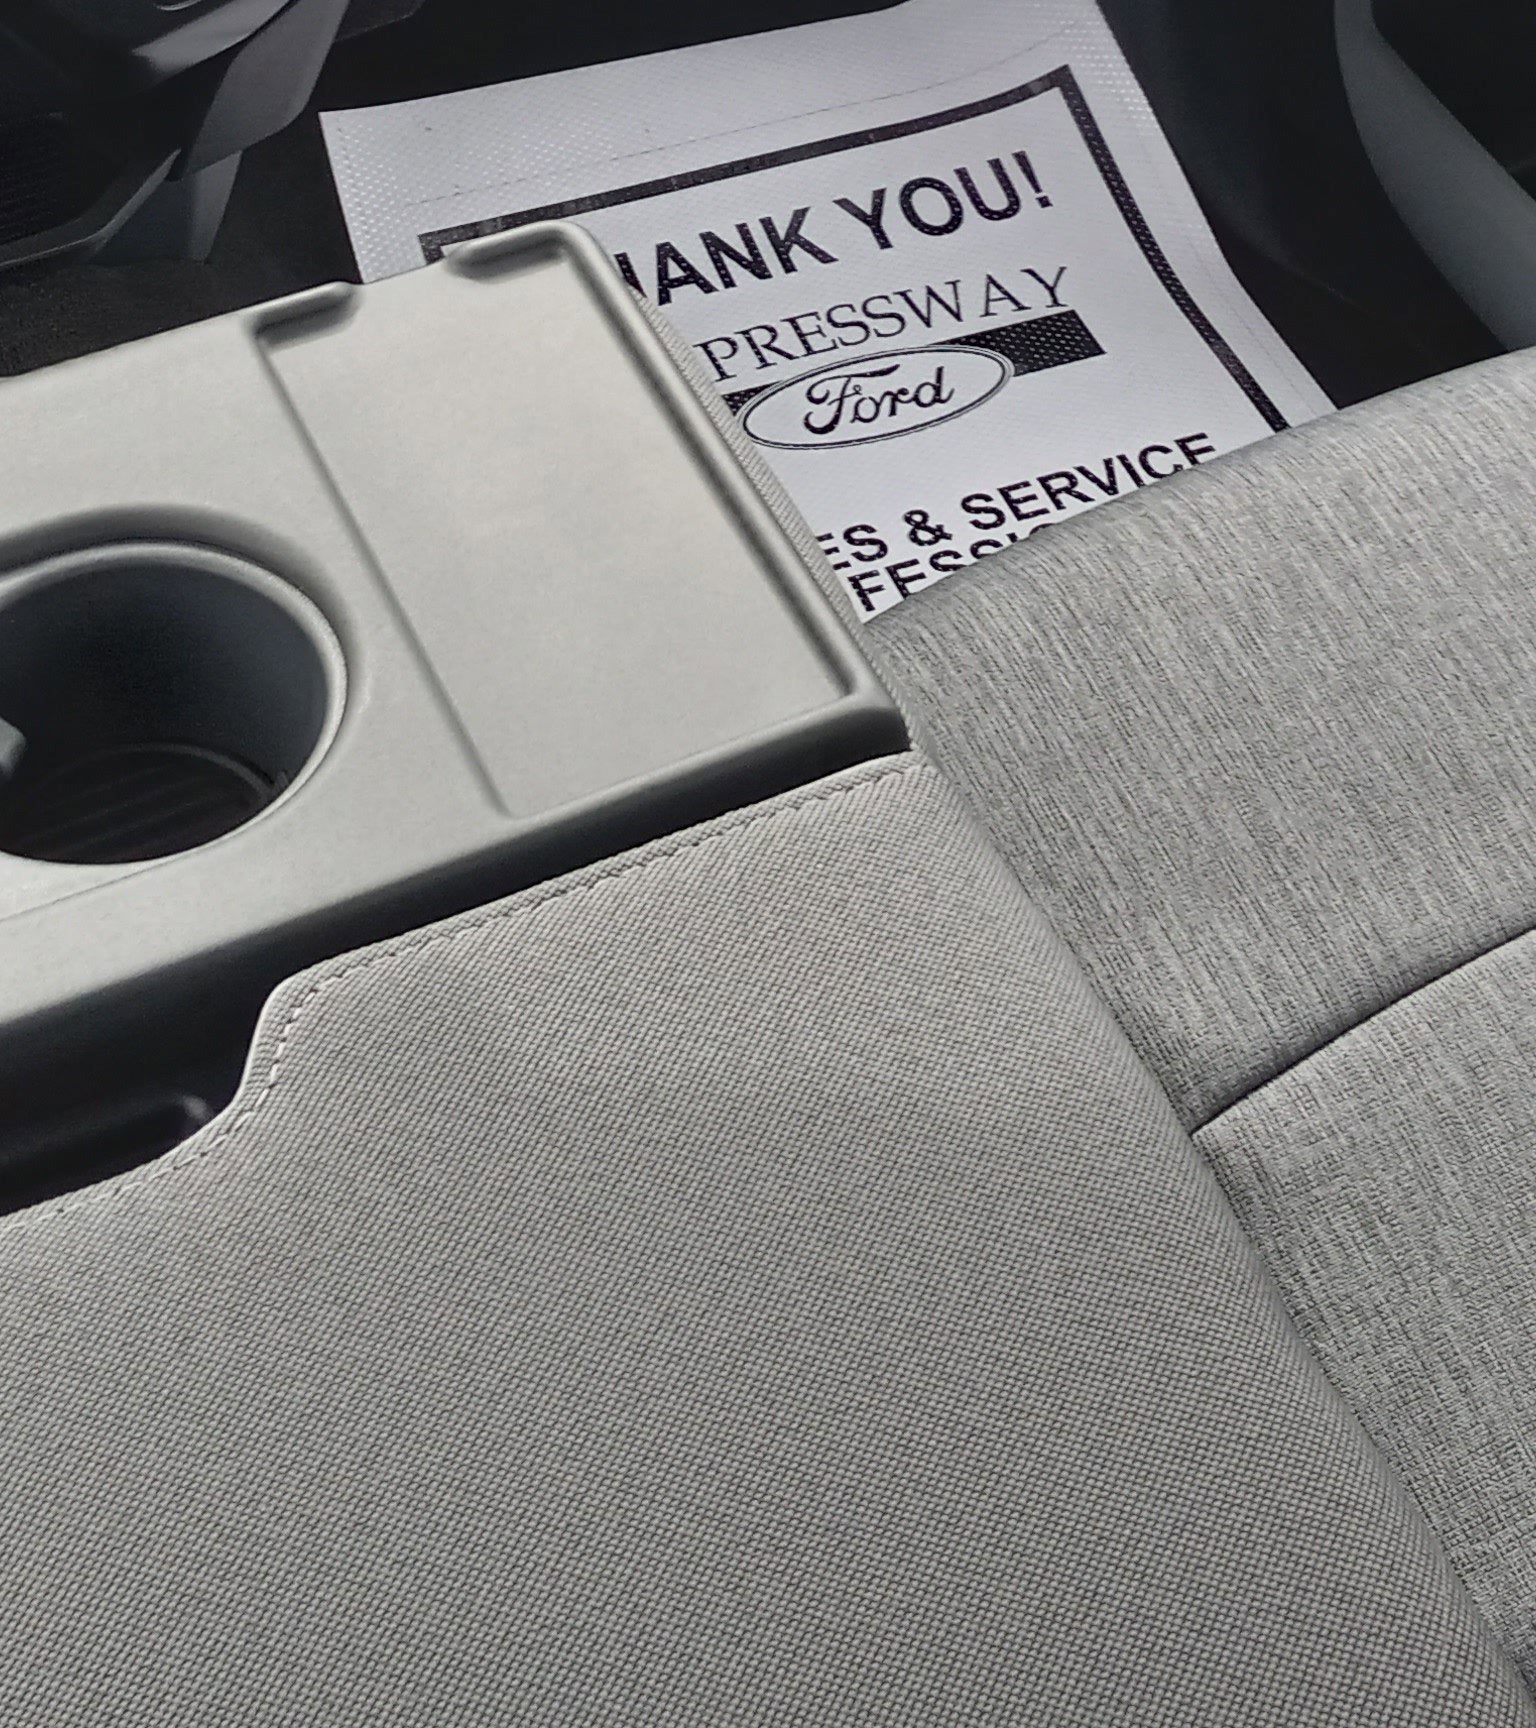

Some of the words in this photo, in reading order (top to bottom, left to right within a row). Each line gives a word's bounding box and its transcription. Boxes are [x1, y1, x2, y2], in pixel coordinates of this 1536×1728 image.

[832, 150, 1054, 250] YOU!
[804, 363, 956, 435] Ford
[902, 509, 953, 547] &
[960, 432, 1216, 531] SERVICE
